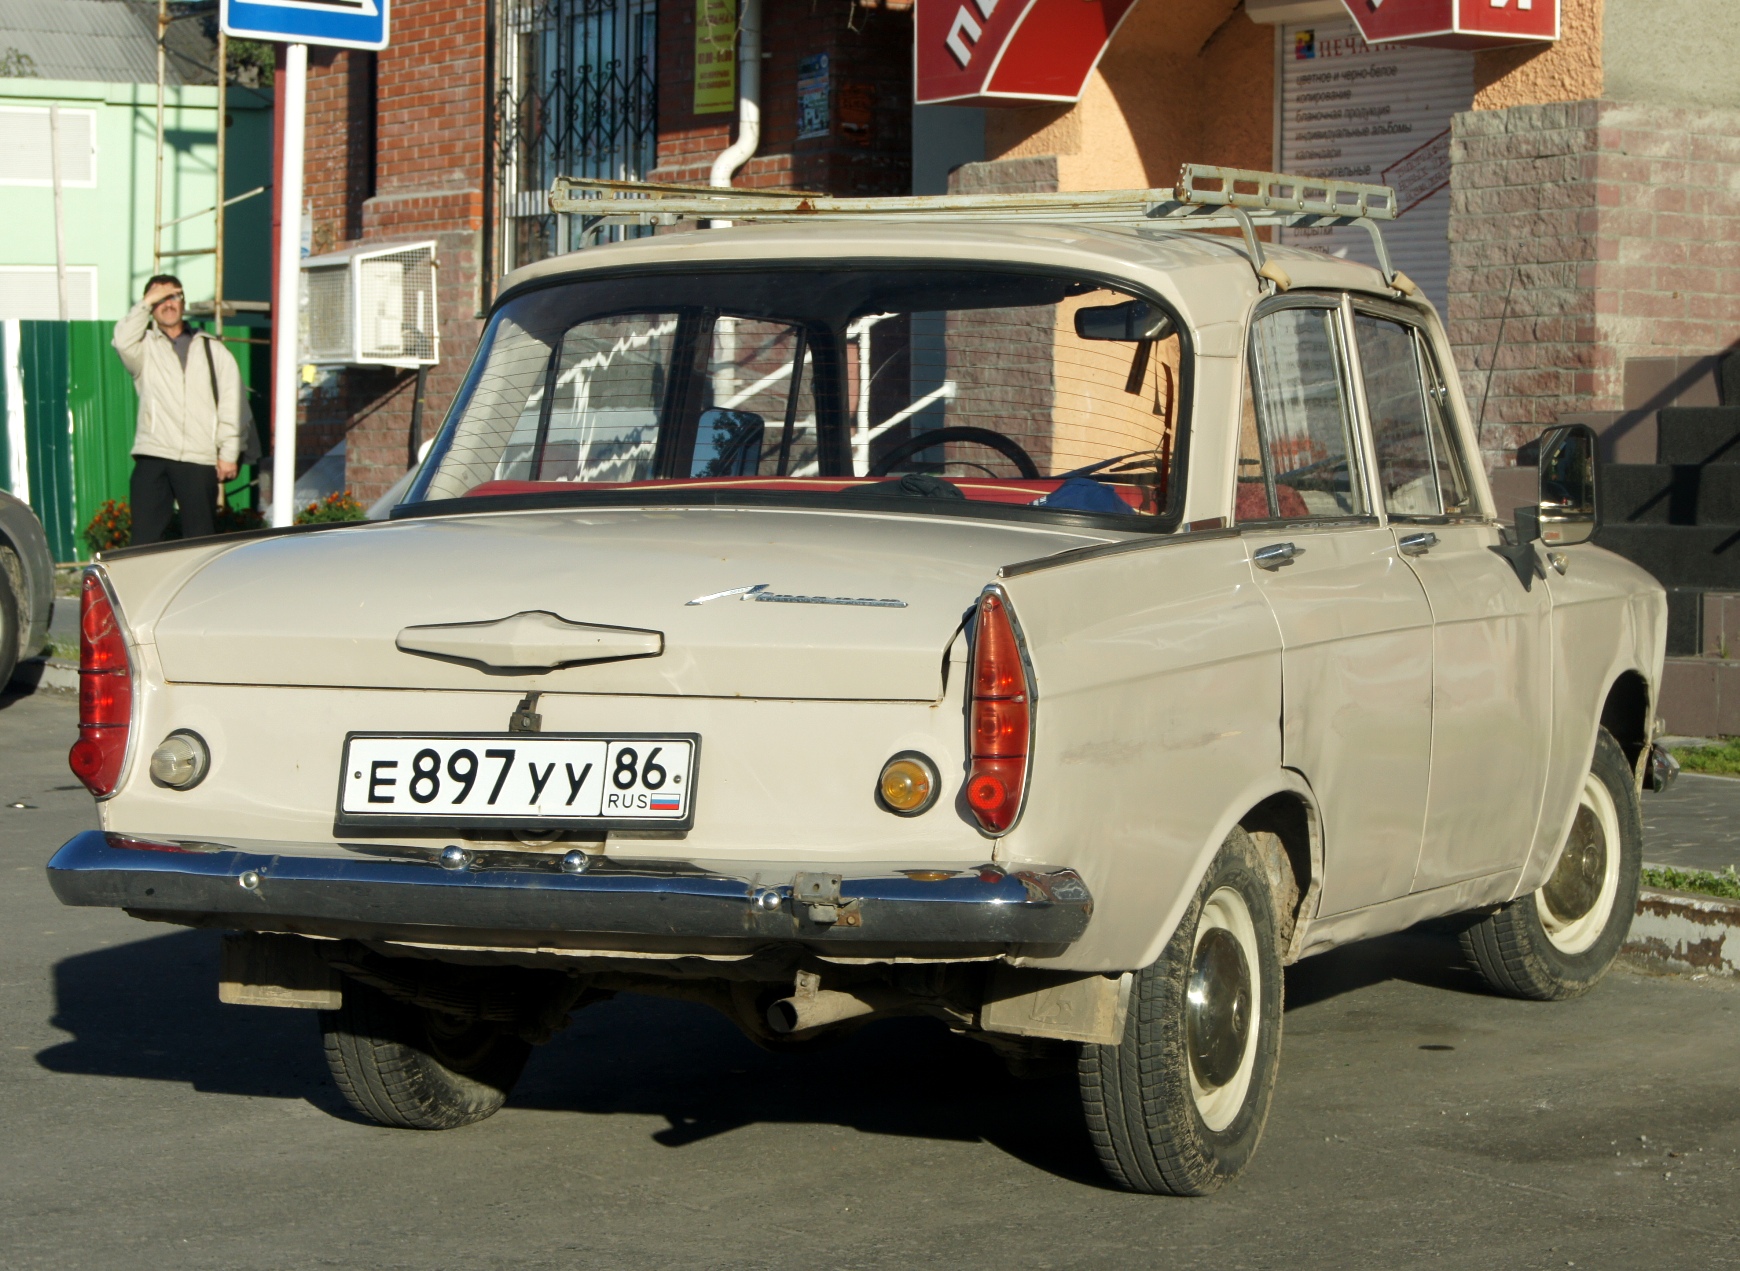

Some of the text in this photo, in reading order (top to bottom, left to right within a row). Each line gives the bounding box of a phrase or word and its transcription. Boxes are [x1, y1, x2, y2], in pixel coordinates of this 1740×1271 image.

[1296, 89, 1352, 105] копирование
[1371, 121, 1412, 136] альбомы
[612, 747, 667, 790] 86
[607, 794, 648, 809] RUS
